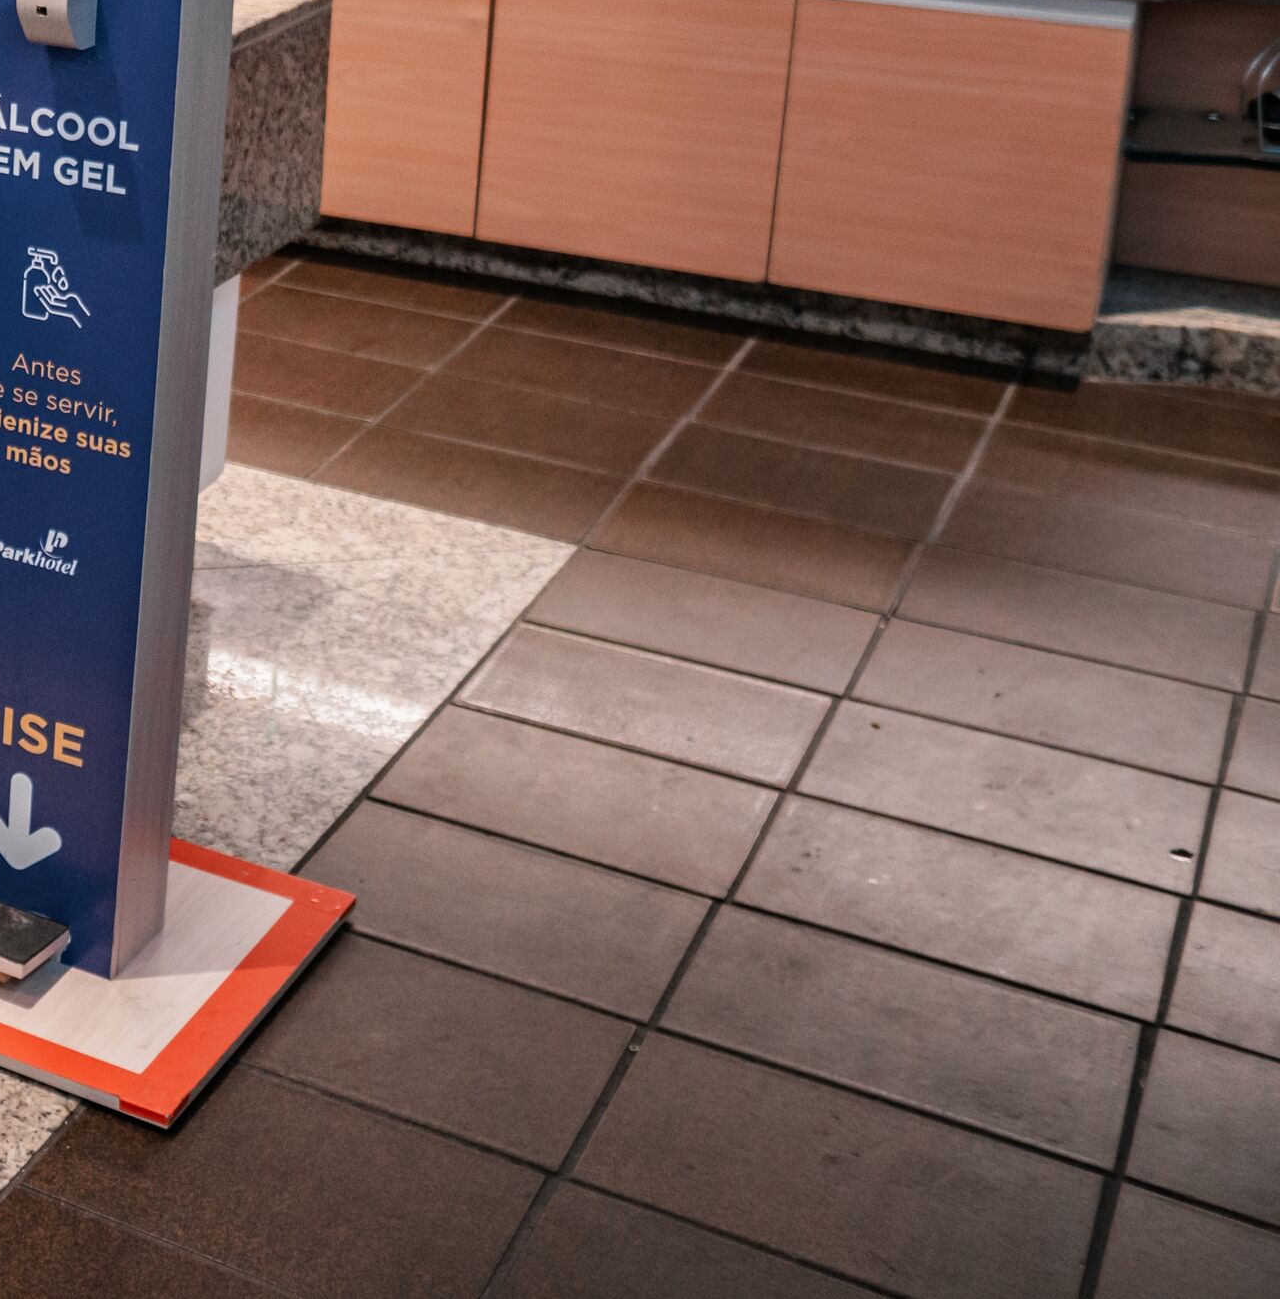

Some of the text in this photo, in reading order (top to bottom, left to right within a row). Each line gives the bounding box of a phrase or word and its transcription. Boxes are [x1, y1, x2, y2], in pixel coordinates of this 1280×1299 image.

[53, 156, 127, 196] GEL
[11, 353, 82, 386] Antes
[12, 387, 39, 407] se
[46, 394, 119, 428] servir,
[5, 445, 72, 475] mãos
[75, 431, 132, 459] suas
